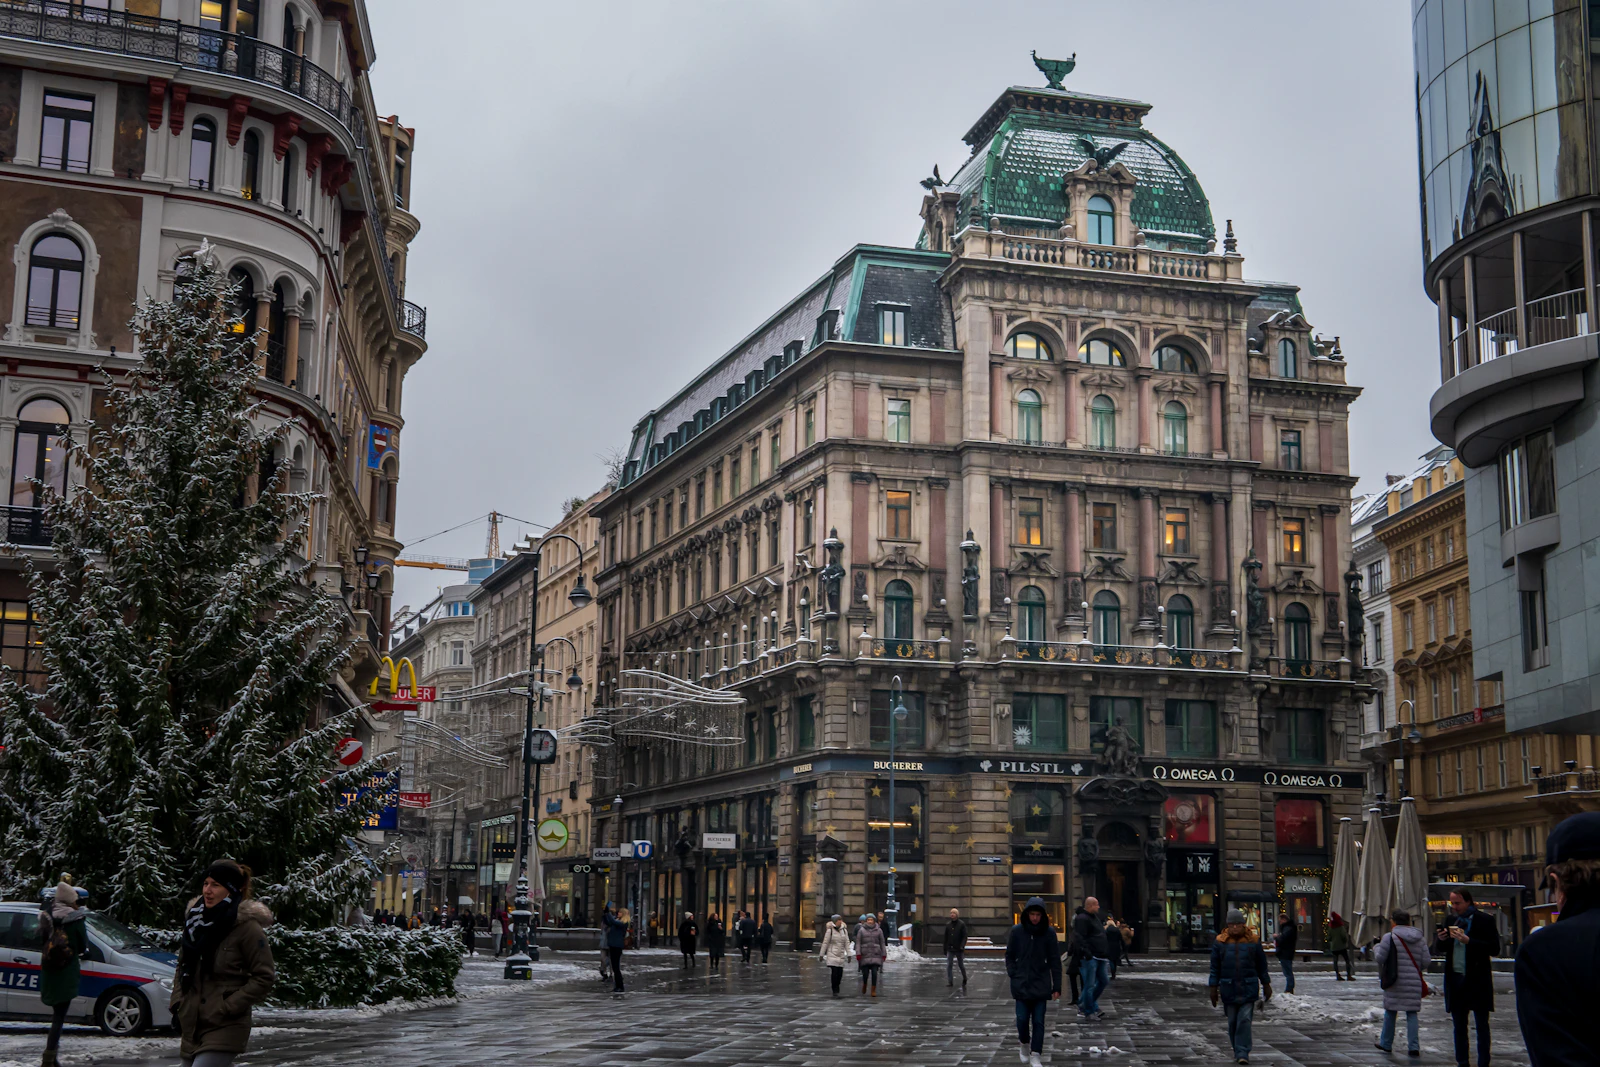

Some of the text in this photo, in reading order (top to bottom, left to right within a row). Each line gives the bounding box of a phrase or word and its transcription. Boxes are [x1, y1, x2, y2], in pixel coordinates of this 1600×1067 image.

[394, 688, 431, 699] UBER
[793, 763, 812, 774] BUCHERER
[873, 761, 923, 771] BUCHERER
[1000, 761, 1064, 774] PILSTL
[1170, 768, 1217, 780] OMEGA
[1280, 774, 1326, 787] OMEGA
[638, 845, 650, 857] U
[0, 971, 39, 988] LIZE
